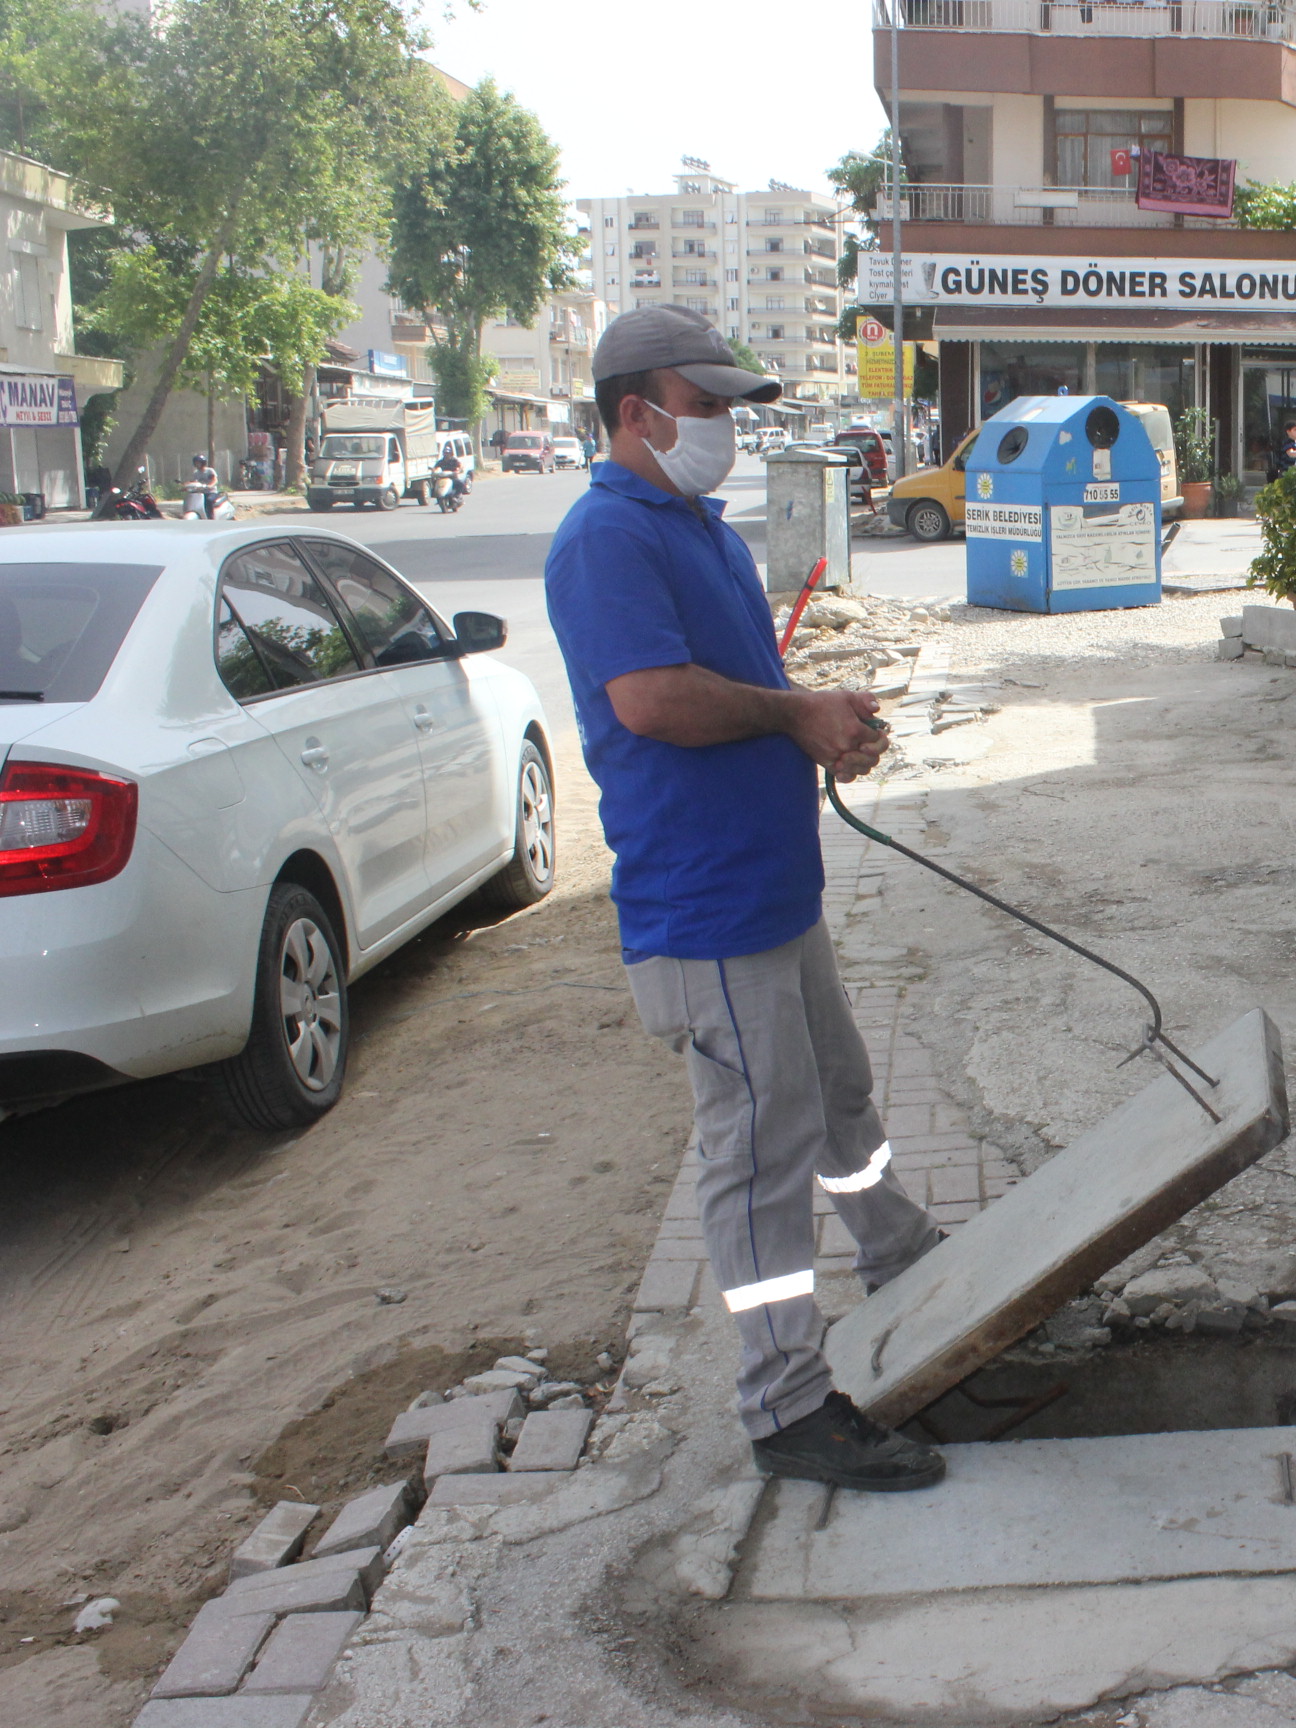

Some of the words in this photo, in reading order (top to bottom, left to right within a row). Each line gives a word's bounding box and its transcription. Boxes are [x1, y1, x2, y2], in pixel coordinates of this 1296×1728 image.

[869, 257, 890, 266] Tavuk
[869, 269, 884, 277] Tost
[941, 260, 1049, 303] GÜNEŞ
[1061, 263, 1168, 299] DÖNER
[7, 381, 55, 408] MANAV
[1085, 489, 1098, 501] 710
[1110, 489, 1119, 500] 55
[967, 507, 991, 521] SERİK
[993, 508, 1042, 525] BELEDİYESİ
